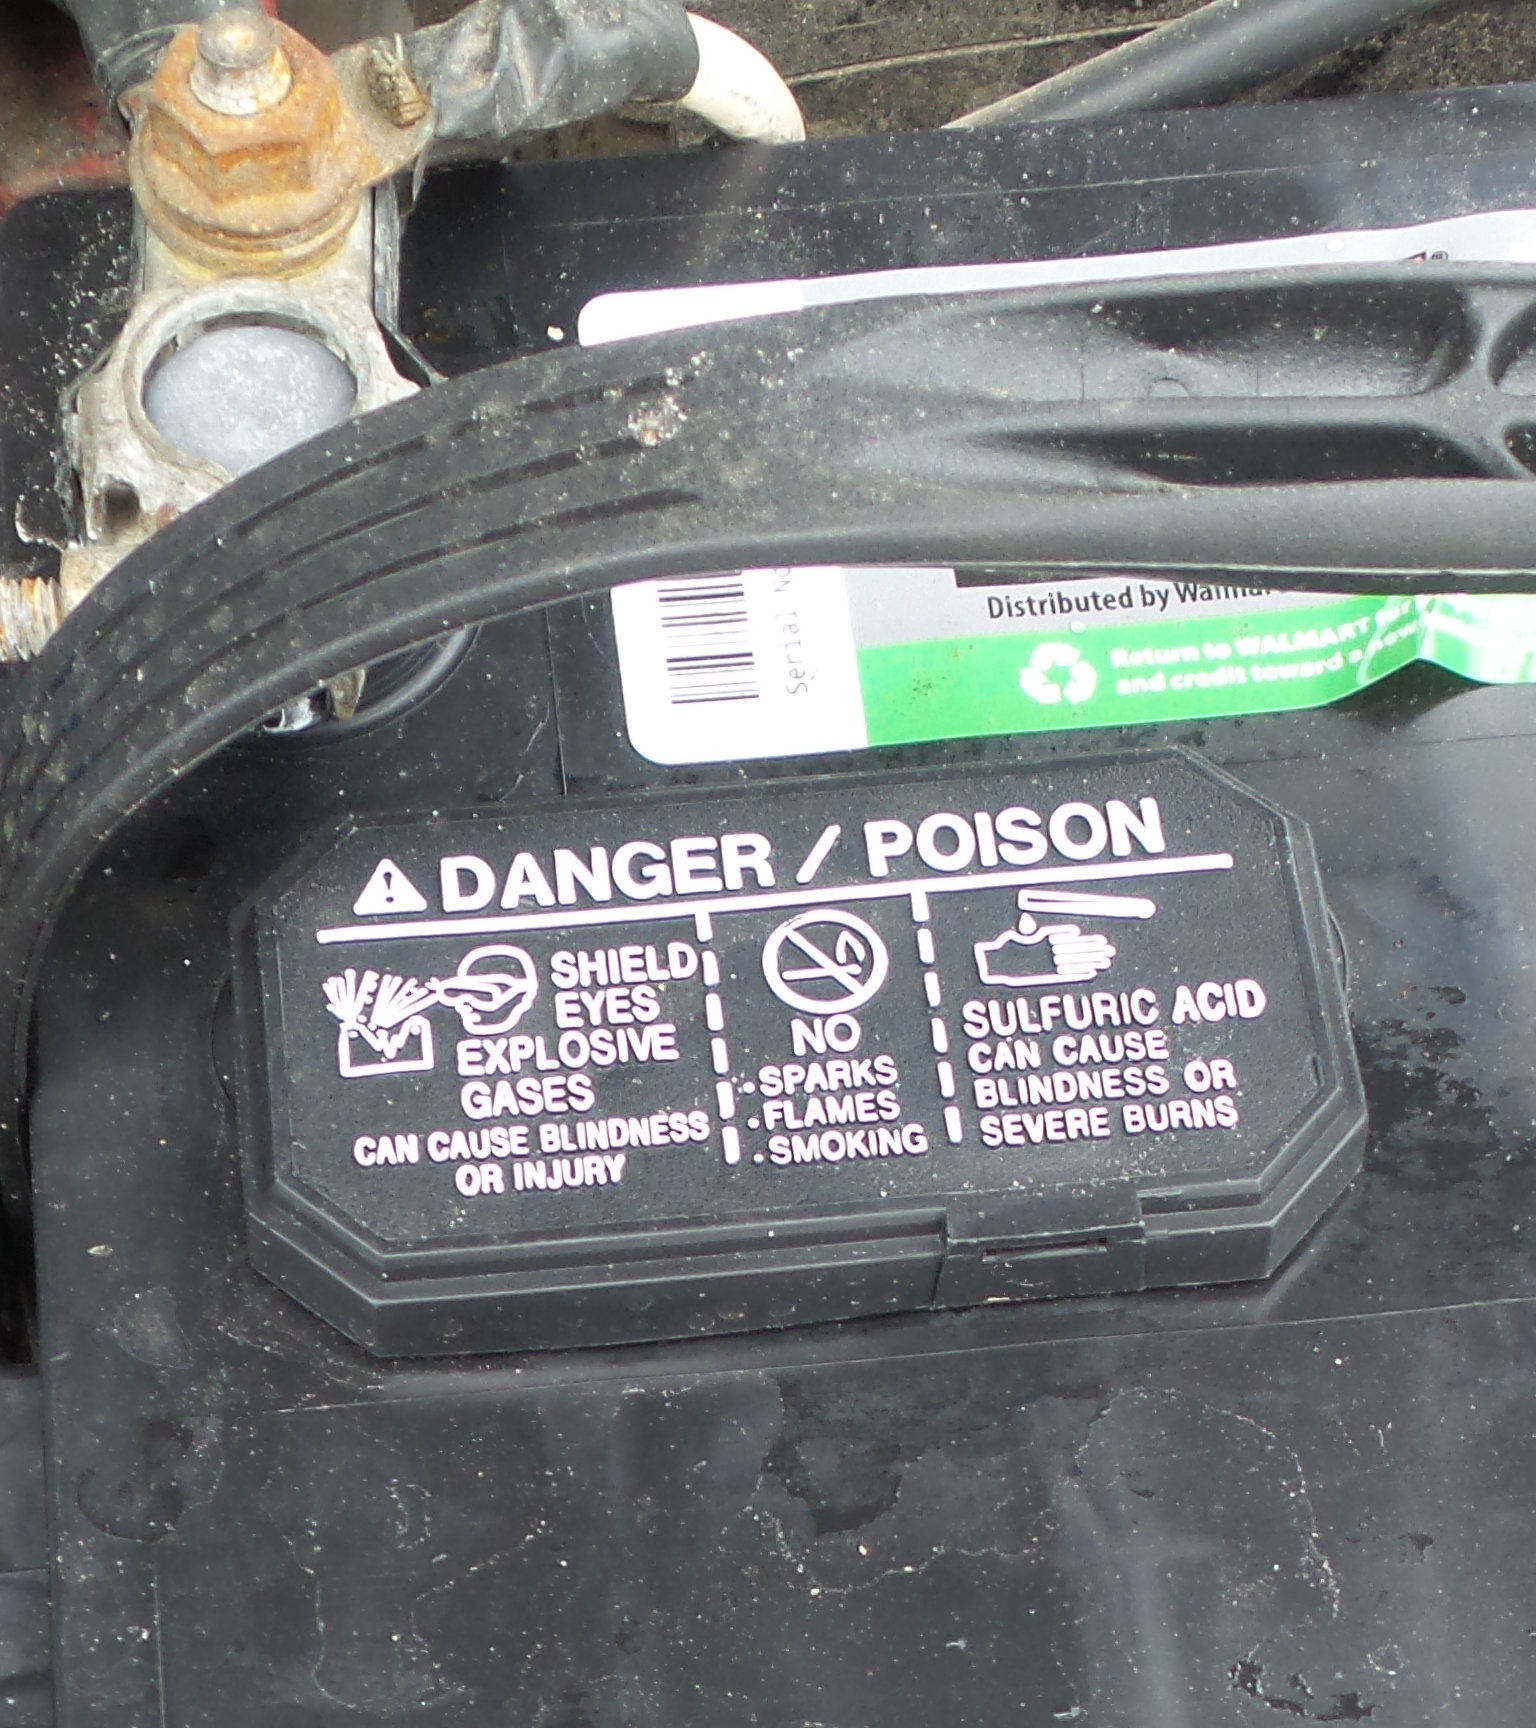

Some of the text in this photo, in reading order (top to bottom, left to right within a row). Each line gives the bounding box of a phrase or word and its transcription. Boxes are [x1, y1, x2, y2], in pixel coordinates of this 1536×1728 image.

[986, 586, 1133, 620] Distributed
[1140, 583, 1170, 612] by
[774, 609, 809, 695] Serial
[1110, 646, 1200, 668] Return
[1202, 642, 1232, 660] to
[1233, 616, 1371, 656] WALMART
[1116, 671, 1166, 695] and
[1169, 661, 1248, 690] credit
[1250, 651, 1344, 683] toward
[440, 796, 1165, 912] DANGER / POISON
[549, 942, 699, 990] SHIELD
[554, 985, 661, 1030] EYES
[962, 979, 1267, 1039] SULFURIC ACID
[456, 1024, 680, 1077] EXPLOSIVE
[790, 1013, 862, 1057] NO
[968, 1029, 1170, 1074] CAN CAUSE
[460, 1074, 596, 1120] GASES
[758, 1055, 899, 1098] SPARKS
[973, 1058, 1237, 1109] BLINDNESS OR
[762, 1090, 901, 1131] FLAMES
[980, 1095, 1239, 1147] SEVERE BURNS
[353, 1111, 711, 1167] CAN CAUSE BLINDNESS
[768, 1123, 929, 1165] SMOKING
[455, 1154, 627, 1197] OR INJURY
